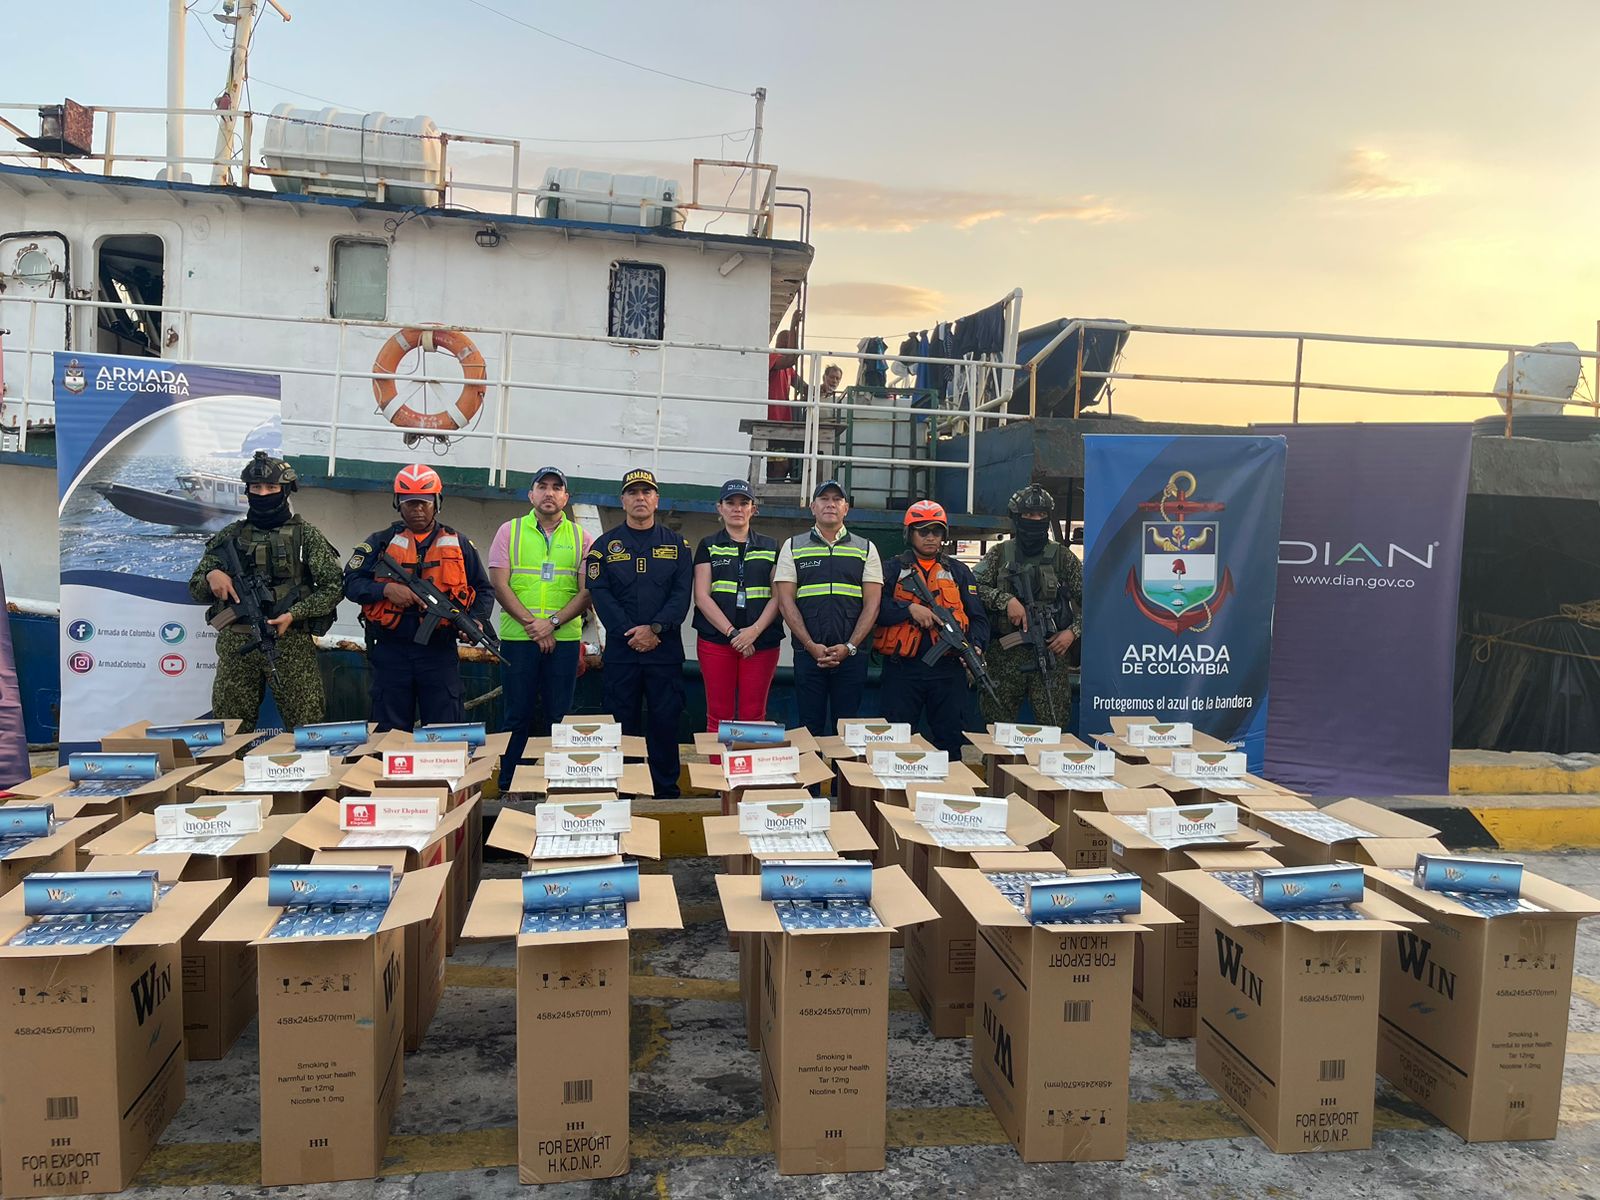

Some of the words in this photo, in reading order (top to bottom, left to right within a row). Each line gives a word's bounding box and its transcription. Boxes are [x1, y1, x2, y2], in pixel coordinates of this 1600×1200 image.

[96, 366, 189, 386] ARMADA
[96, 380, 114, 390] DE
[119, 382, 189, 396] COLOMBIA
[626, 472, 653, 482] ARMADA
[1293, 575, 1415, 589] www.dian.gov.co
[129, 629, 156, 637] Colombia
[1123, 644, 1230, 662] ARMADA
[98, 660, 146, 668] ArmadaColombia
[1122, 663, 1143, 674] DE
[1148, 663, 1229, 675] COLOMBIA
[1094, 696, 1154, 712] Protegemos
[1157, 696, 1165, 710] el
[1168, 696, 1189, 710] azul
[1192, 696, 1203, 711] de
[1206, 697, 1213, 710] la
[1214, 695, 1252, 709] bandera
[268, 767, 305, 778] MODERN
[567, 766, 603, 776] MODERN
[401, 807, 429, 815] Elephant
[765, 818, 807, 830] MODERN
[940, 812, 983, 824] MODERN
[184, 820, 231, 834] MODERN
[562, 819, 606, 831] MODERN
[1177, 822, 1216, 835] MODERN
[1048, 953, 1091, 968] EXPORT
[1093, 953, 1116, 966] FOR
[1214, 928, 1263, 1007] WIN
[1397, 931, 1457, 1001] WIN
[1073, 974, 1090, 983] HH
[131, 961, 171, 1027] WIN
[536, 1008, 612, 1021] 458x245x570(mm)
[799, 1007, 871, 1016] 458x245x570(mm)
[277, 1013, 355, 1025] 458x245x570(mm)
[14, 1025, 96, 1036] 458x245x570(mm)
[983, 1002, 1014, 1089] WIN
[816, 1054, 845, 1062] Smoking
[297, 1061, 329, 1070] Smoking
[798, 1065, 823, 1073] harmful
[277, 1074, 306, 1083] harmful
[307, 1073, 315, 1081] to
[316, 1074, 333, 1082] your
[301, 1085, 312, 1093] Tar
[314, 1084, 335, 1092] 12mg
[290, 1097, 320, 1105] Nicotine
[1321, 1097, 1336, 1106] HH
[566, 1121, 585, 1131] HH
[1295, 1113, 1316, 1128] FOR
[1319, 1112, 1359, 1126] EXPORT
[825, 1129, 843, 1138] HH
[1303, 1128, 1350, 1144] H.K.D.N.P.
[51, 1137, 71, 1146] HH
[309, 1138, 329, 1148] HH
[538, 1140, 562, 1156] FOR
[566, 1135, 611, 1153] EXPORT
[22, 1155, 47, 1171] FOR
[51, 1152, 100, 1168] EXPORT
[548, 1154, 602, 1173] H.K.D.N.P.
[33, 1170, 92, 1187] H.K.D.N.P.
